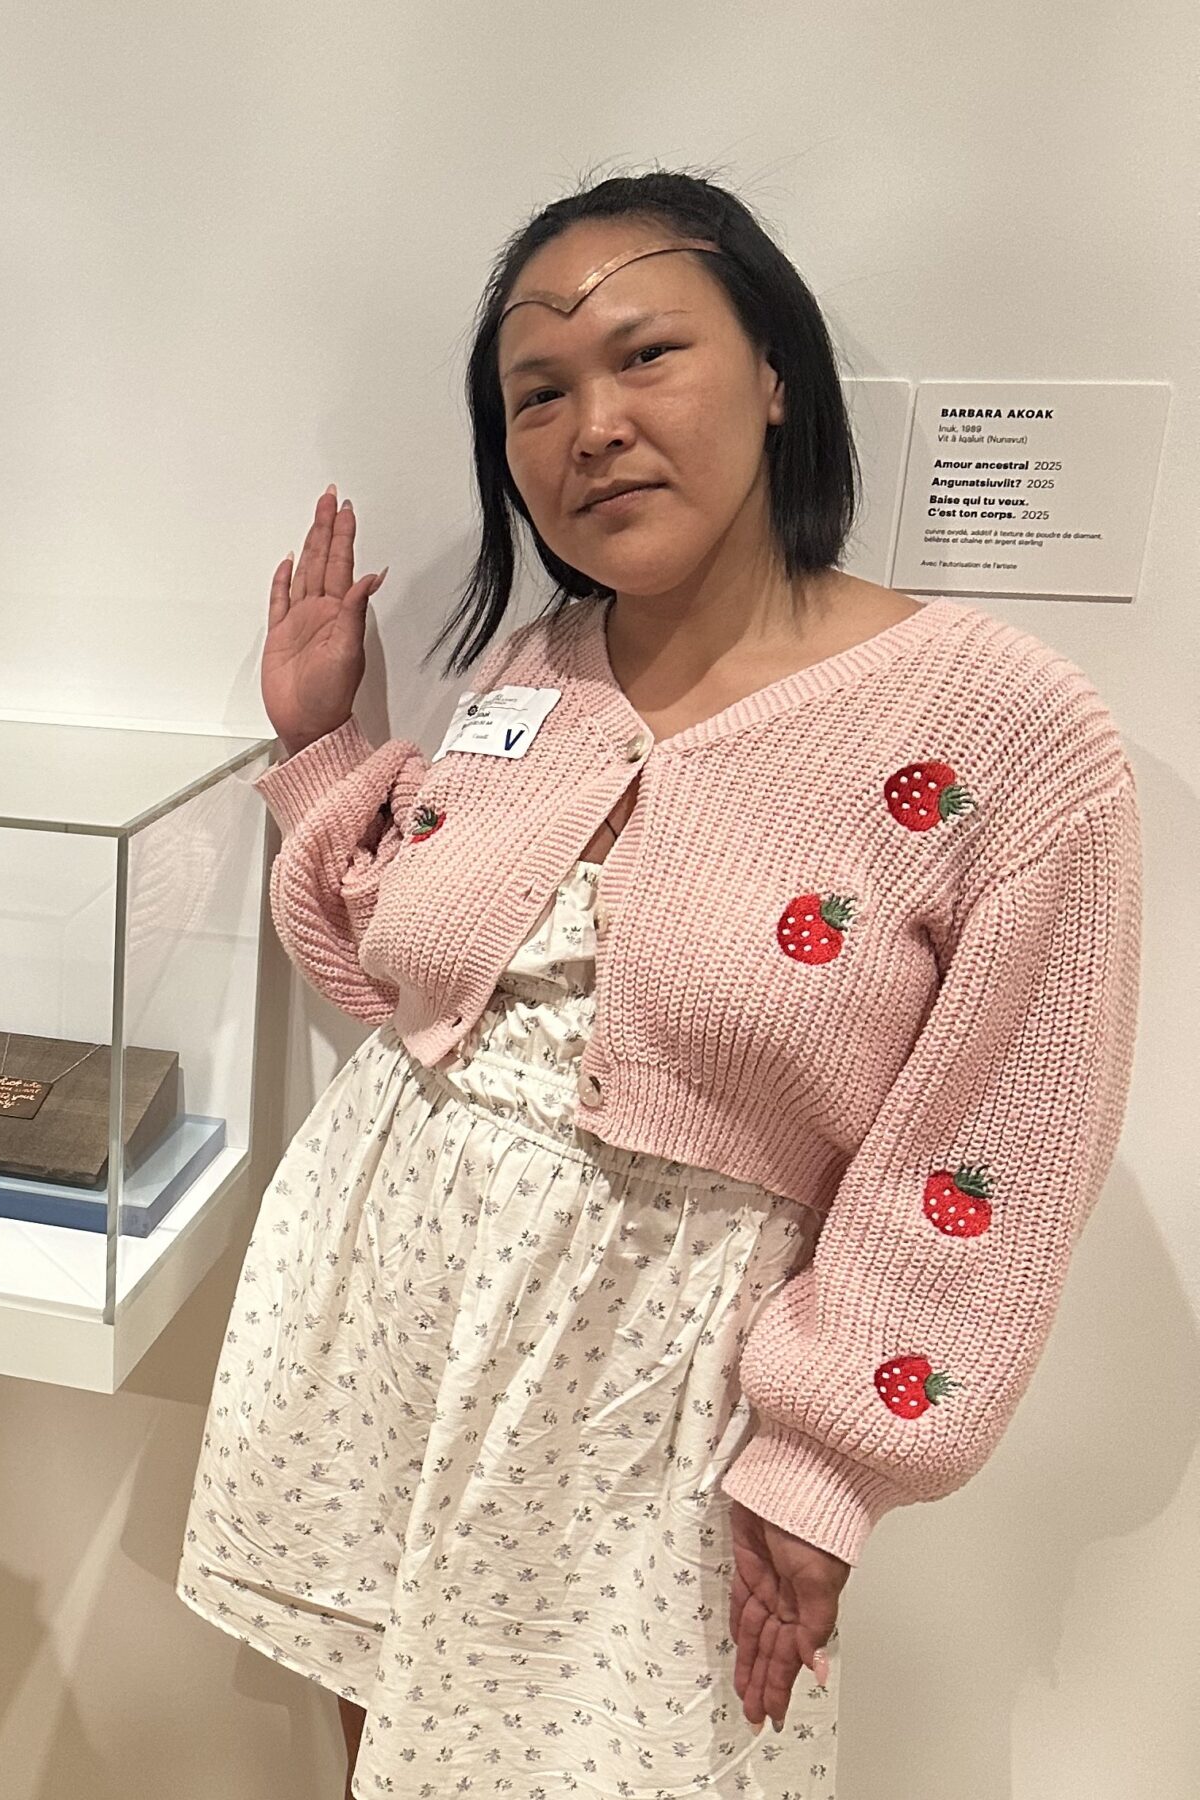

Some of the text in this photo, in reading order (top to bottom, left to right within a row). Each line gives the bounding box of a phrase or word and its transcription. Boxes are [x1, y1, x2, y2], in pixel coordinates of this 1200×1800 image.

[941, 408, 1054, 419] BARBARA AKOAK
[962, 425, 982, 433] 1989
[987, 436, 1028, 445] (Nunavut)
[934, 459, 1062, 471] Amour ancestral 2025
[1026, 479, 1055, 489] 2025
[929, 495, 1029, 506] Baise qui tu veux.
[928, 508, 1050, 520] C'est ton corps. 2025
[504, 729, 525, 751] V
